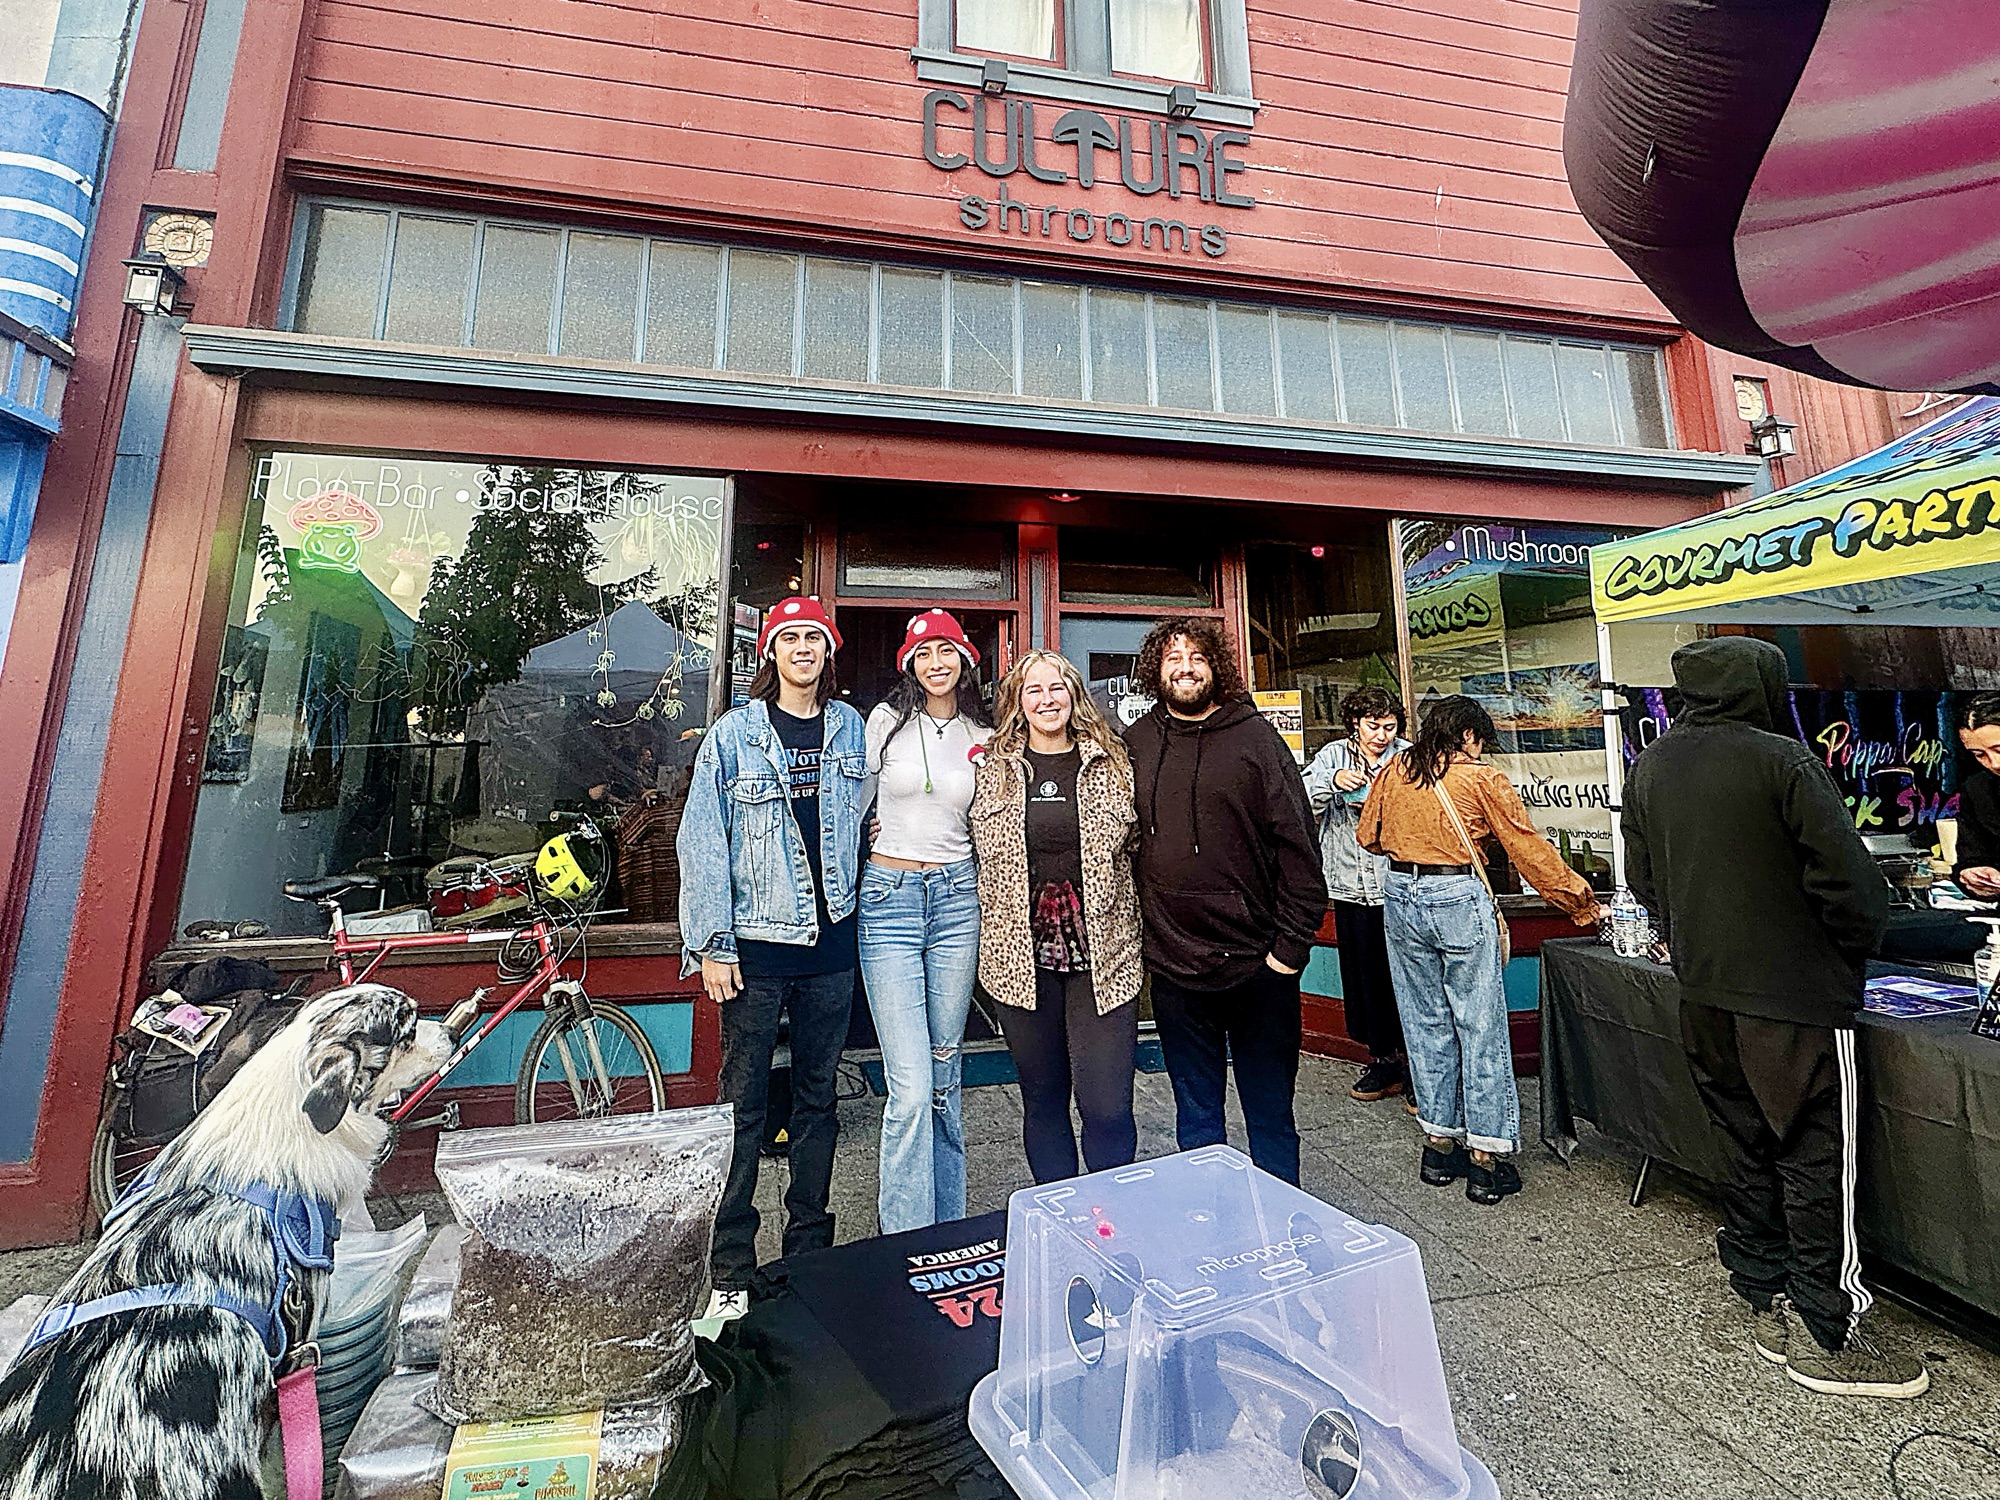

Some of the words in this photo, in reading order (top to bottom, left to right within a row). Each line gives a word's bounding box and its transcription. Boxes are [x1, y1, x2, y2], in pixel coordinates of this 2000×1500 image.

[959, 182, 1228, 258] shrooms
[471, 469, 586, 514] Social
[606, 476, 723, 521] House
[1604, 519, 1824, 602] GOURMET
[907, 1239, 999, 1267] AMERICA
[1196, 1233, 1322, 1277] microppose
